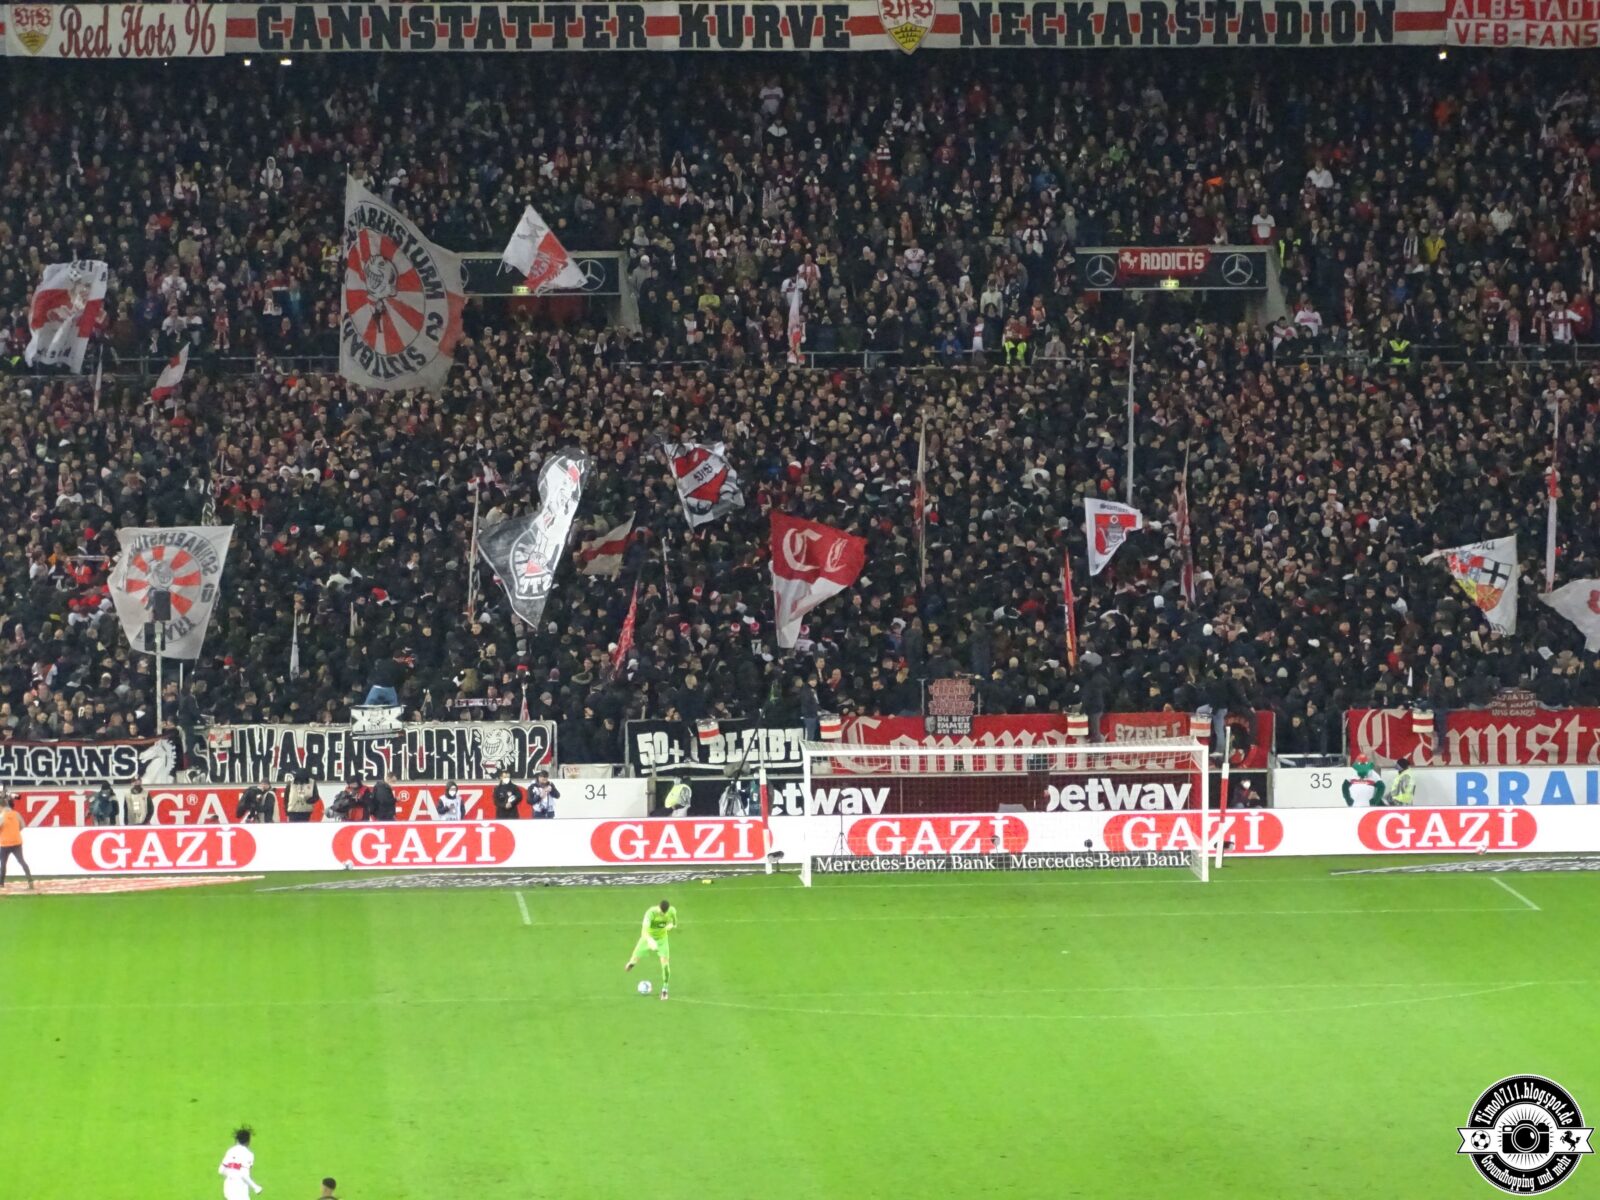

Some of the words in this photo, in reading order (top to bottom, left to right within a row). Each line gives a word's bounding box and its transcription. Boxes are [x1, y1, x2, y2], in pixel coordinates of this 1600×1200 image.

[59, 4, 112, 58] Red
[119, 4, 176, 57] Hots
[185, 3, 216, 55] 96
[257, 3, 647, 52] CANNSTATTER
[679, 2, 850, 50] KURVE
[959, 1, 1394, 48] NECKARSTADION
[1454, 22, 1600, 47] VFB-FANS
[1140, 251, 1205, 271] ADDICTS
[708, 727, 804, 763] BLEIBT
[584, 784, 608, 800] 34
[1310, 773, 1332, 789] 35
[815, 855, 946, 872] Mercedes-Benz
[952, 854, 996, 870] Bank
[1010, 852, 1141, 869] Mercedes-Benz
[1148, 852, 1191, 867] Bank
